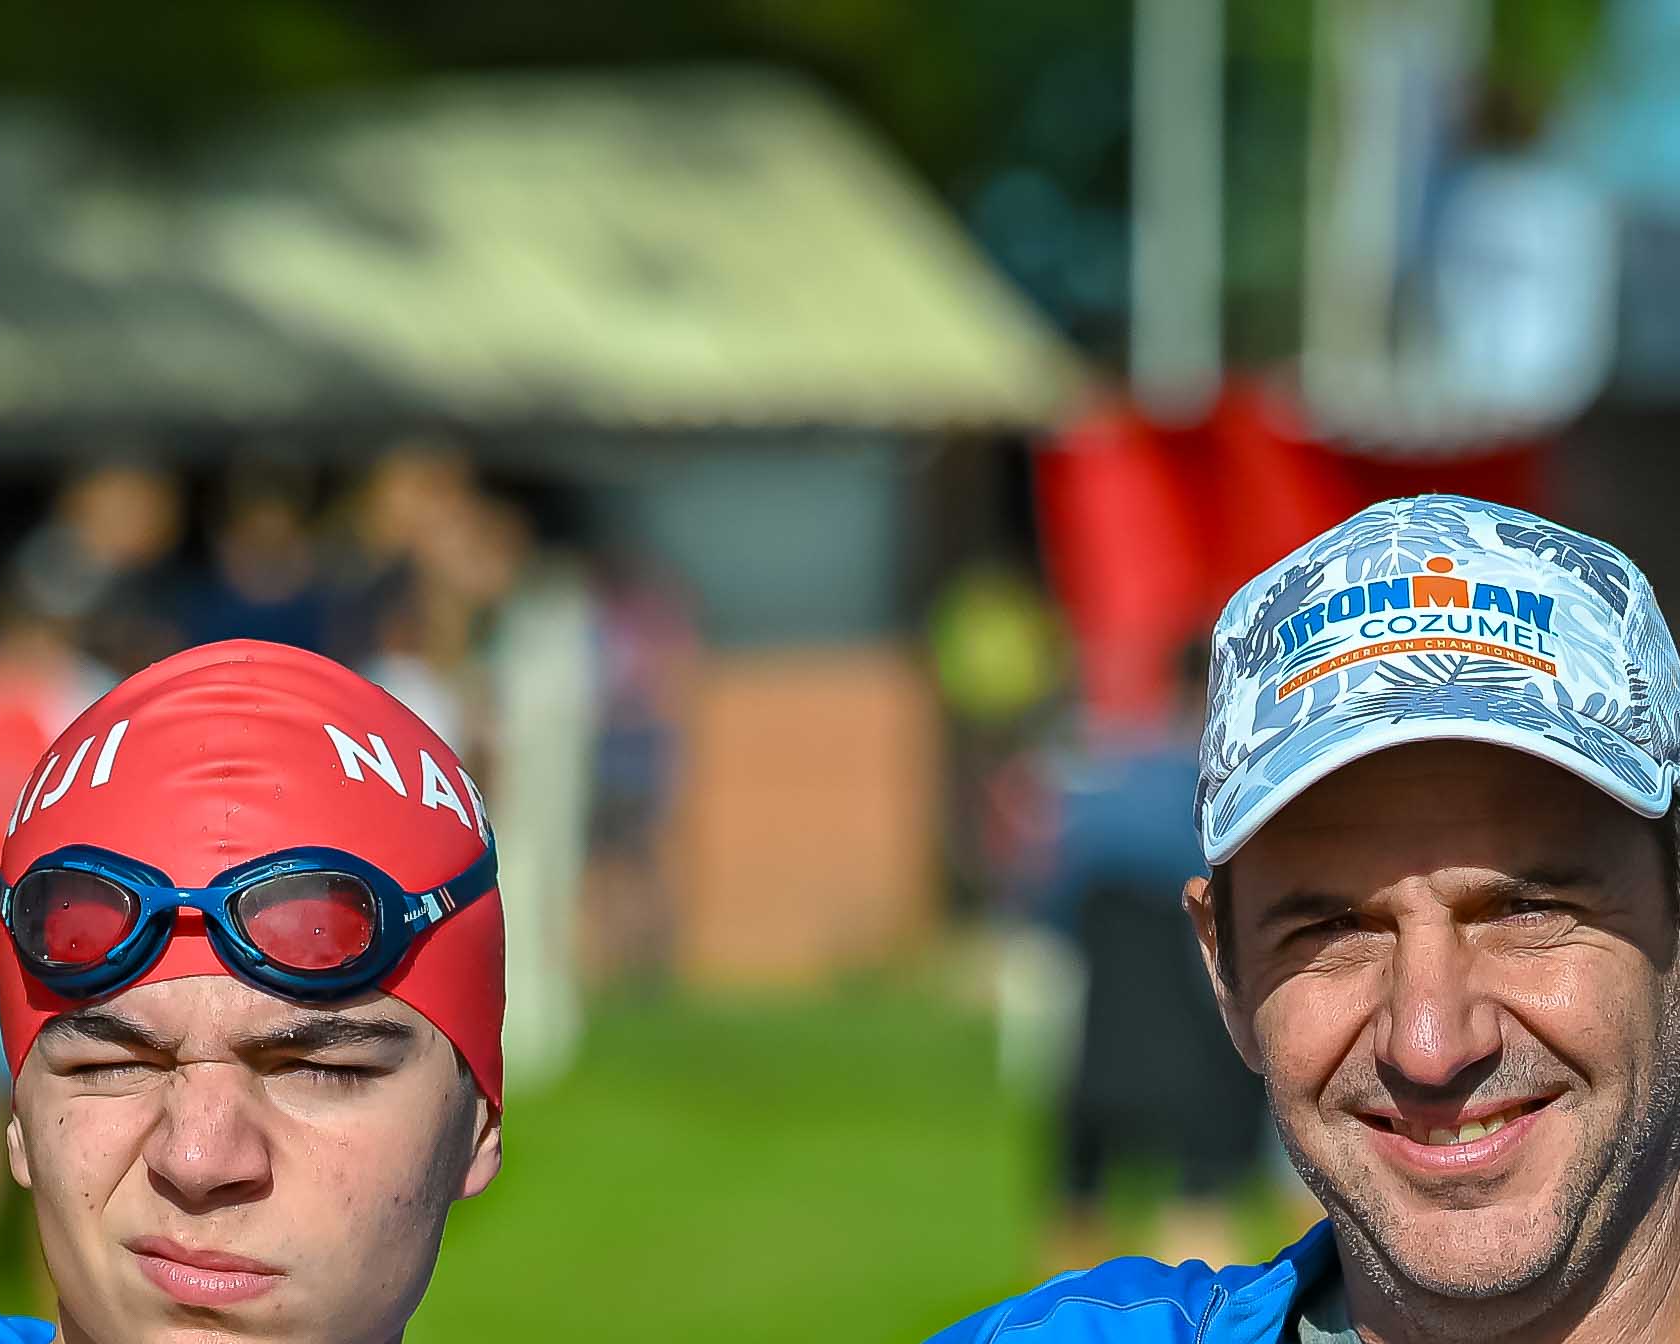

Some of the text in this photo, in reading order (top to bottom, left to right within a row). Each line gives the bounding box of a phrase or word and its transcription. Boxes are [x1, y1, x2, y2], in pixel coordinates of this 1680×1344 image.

[1277, 557, 1555, 661] IRONMAN
[1359, 613, 1556, 658] COZUMEL
[1280, 638, 1556, 696] LATIN AMERICAN CHAMPIONSHIP
